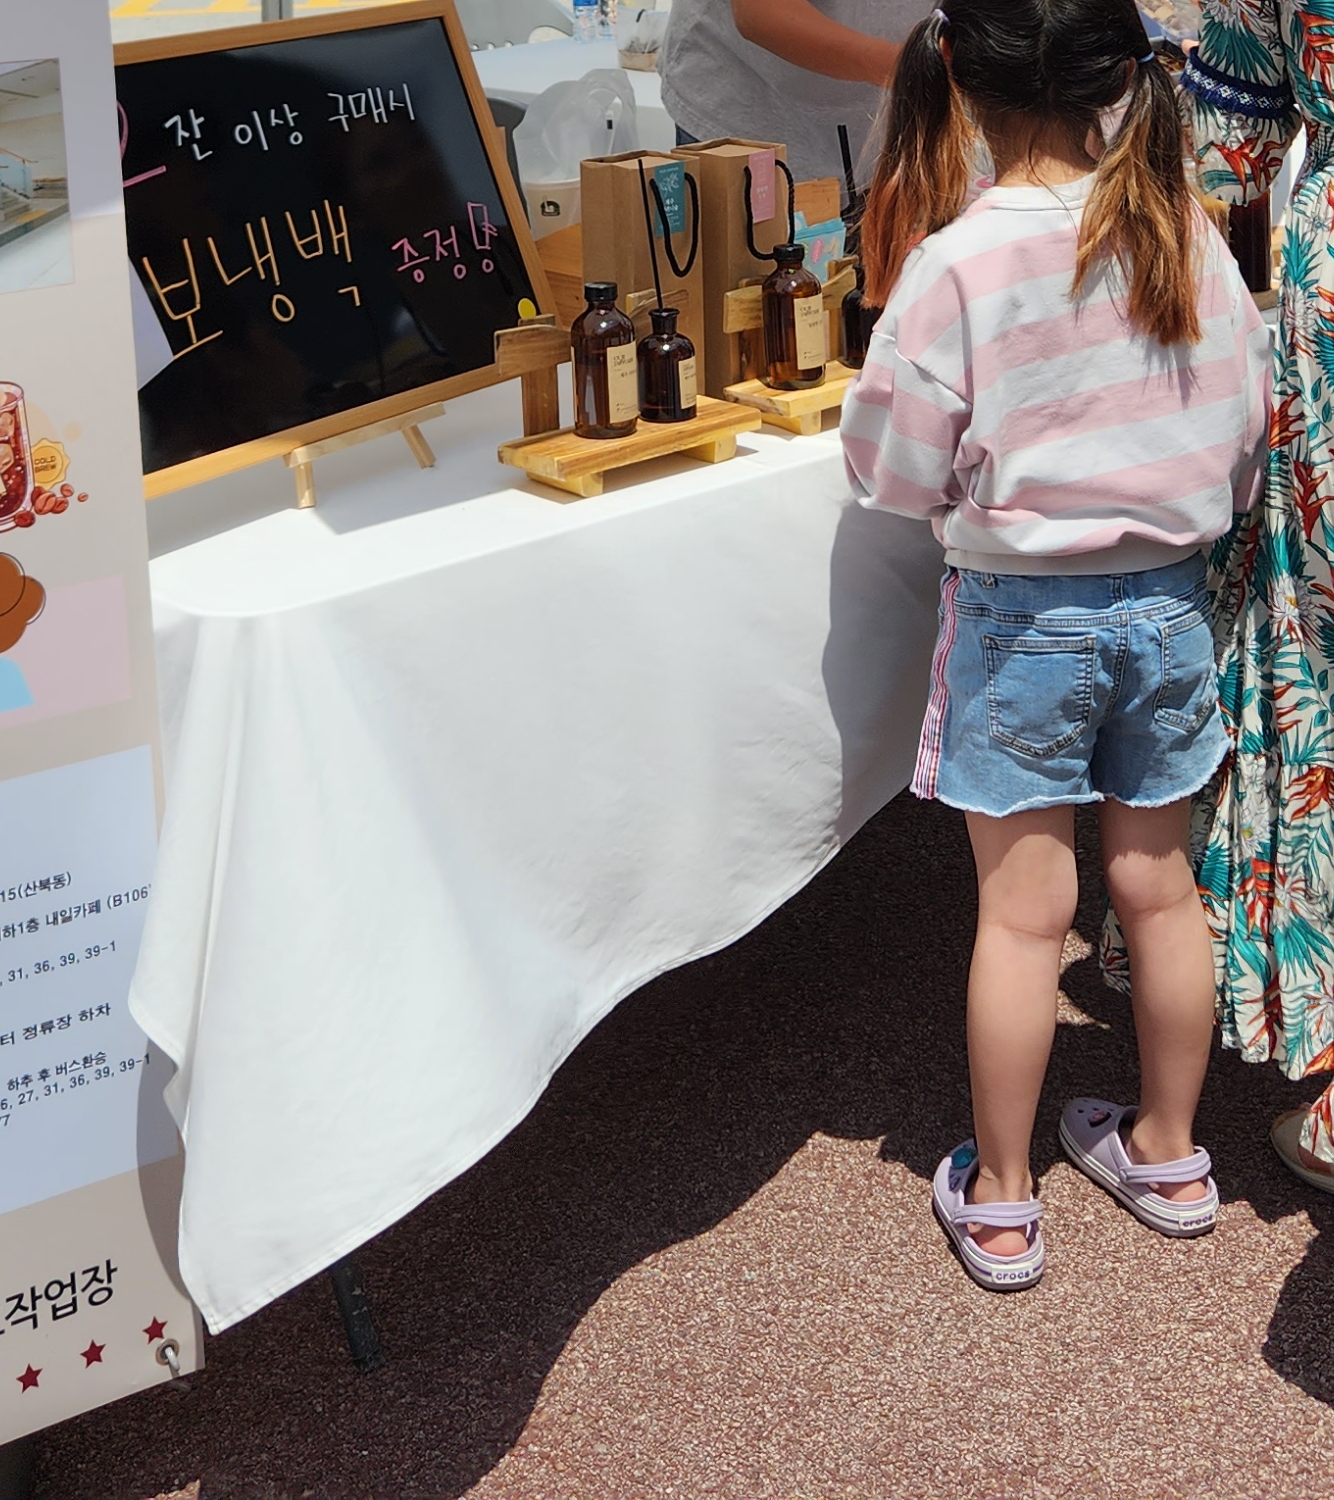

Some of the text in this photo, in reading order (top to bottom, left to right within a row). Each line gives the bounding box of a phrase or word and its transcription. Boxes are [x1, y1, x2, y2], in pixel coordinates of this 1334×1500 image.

[233, 103, 303, 151] 이상
[327, 83, 416, 133] 구매시
[142, 199, 362, 359] 보냉백
[34, 455, 57, 466] COLD
[46, 899, 102, 927] 내일카페
[107, 884, 152, 910] (B106
[7, 967, 29, 982] 31,
[34, 960, 55, 976] 36,
[59, 952, 81, 967] 39,
[84, 940, 116, 960] 39-1
[22, 1014, 72, 1041] 정류장
[78, 1002, 111, 1022] 하차
[18, 1089, 39, 1105] 27,
[43, 1082, 65, 1097] 31,
[69, 1073, 90, 1089] 36,
[94, 1066, 115, 1081] 39,
[119, 1053, 150, 1073] 39-1
[37, 1068, 51, 1083] 후
[55, 1051, 107, 1076] 버스환승
